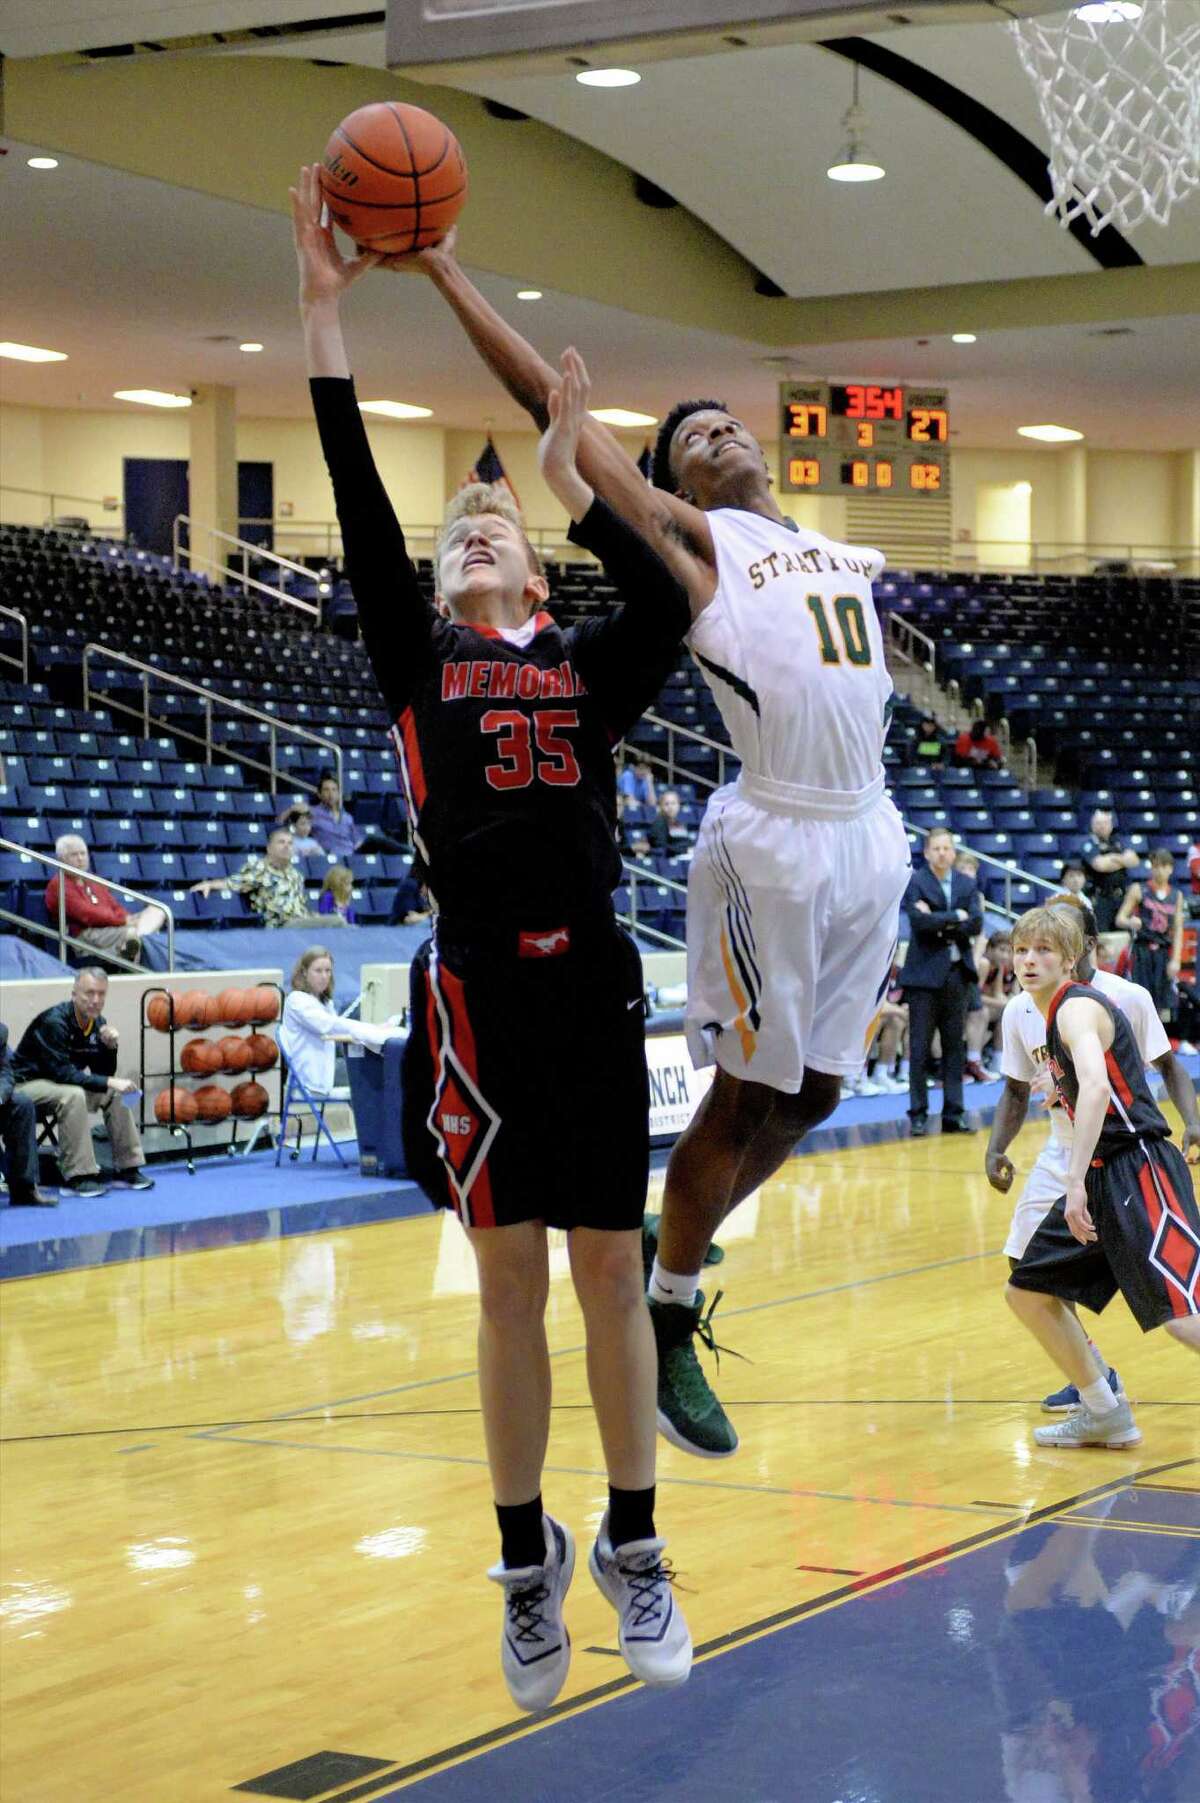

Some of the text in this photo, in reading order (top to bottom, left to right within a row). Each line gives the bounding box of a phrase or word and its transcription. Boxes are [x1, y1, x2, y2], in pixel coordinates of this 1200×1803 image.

[789, 404, 827, 437] 37
[857, 423, 874, 448] 3
[911, 409, 948, 442] 27
[806, 593, 872, 668] 10
[480, 709, 582, 791] 35
